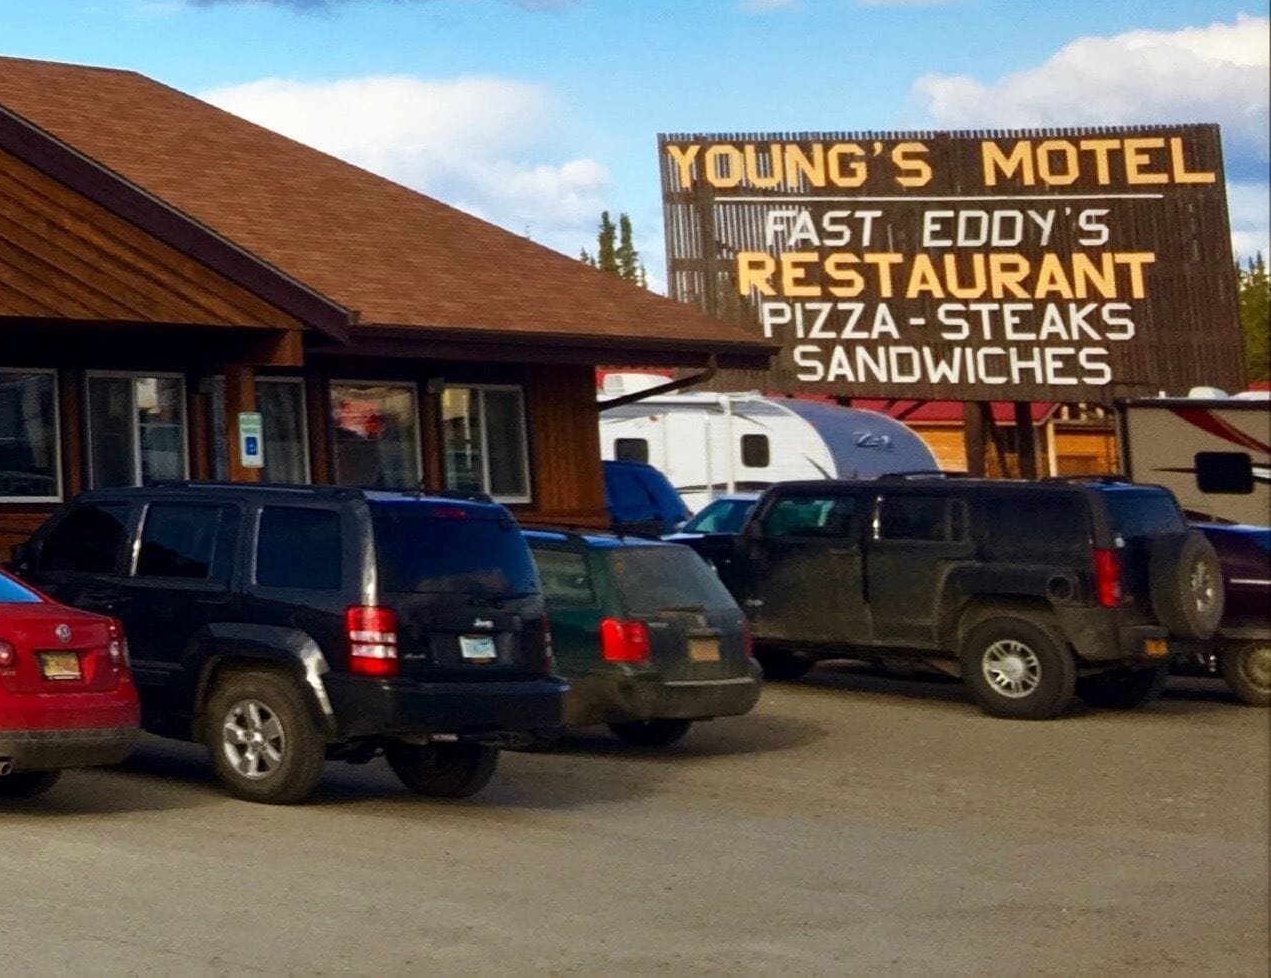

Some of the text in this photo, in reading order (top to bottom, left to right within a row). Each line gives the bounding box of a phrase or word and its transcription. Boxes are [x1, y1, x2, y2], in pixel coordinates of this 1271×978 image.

[666, 137, 1216, 188] YOUNG'S MOTEL
[765, 207, 1111, 248] FAST EDDY'S
[737, 250, 1156, 300] RESTAURANT
[792, 345, 1112, 386] SANDWICHES
